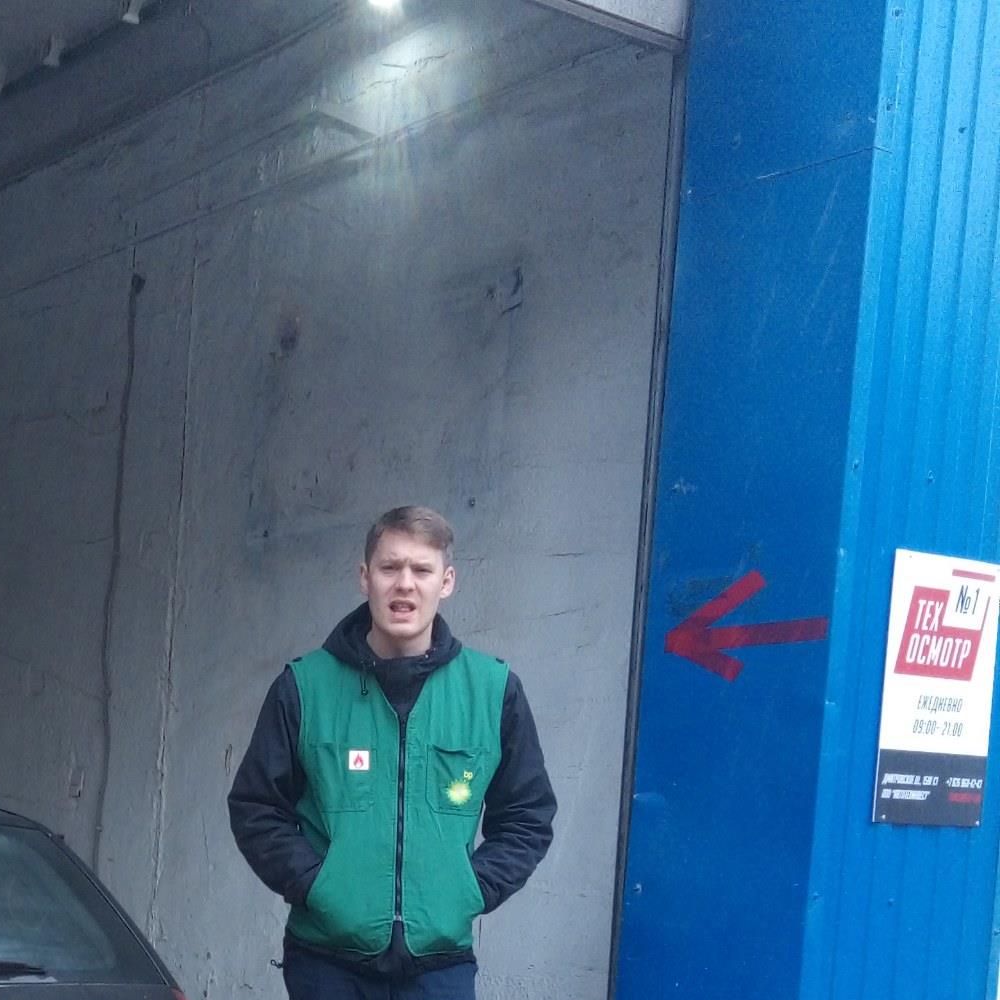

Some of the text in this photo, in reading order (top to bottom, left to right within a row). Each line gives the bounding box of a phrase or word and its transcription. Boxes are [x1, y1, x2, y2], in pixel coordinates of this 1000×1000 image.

[913, 599, 944, 632] ТЕХ
[905, 633, 972, 669] ОСМОТР
[916, 694, 964, 714] ЕЖЕДНЕВНО
